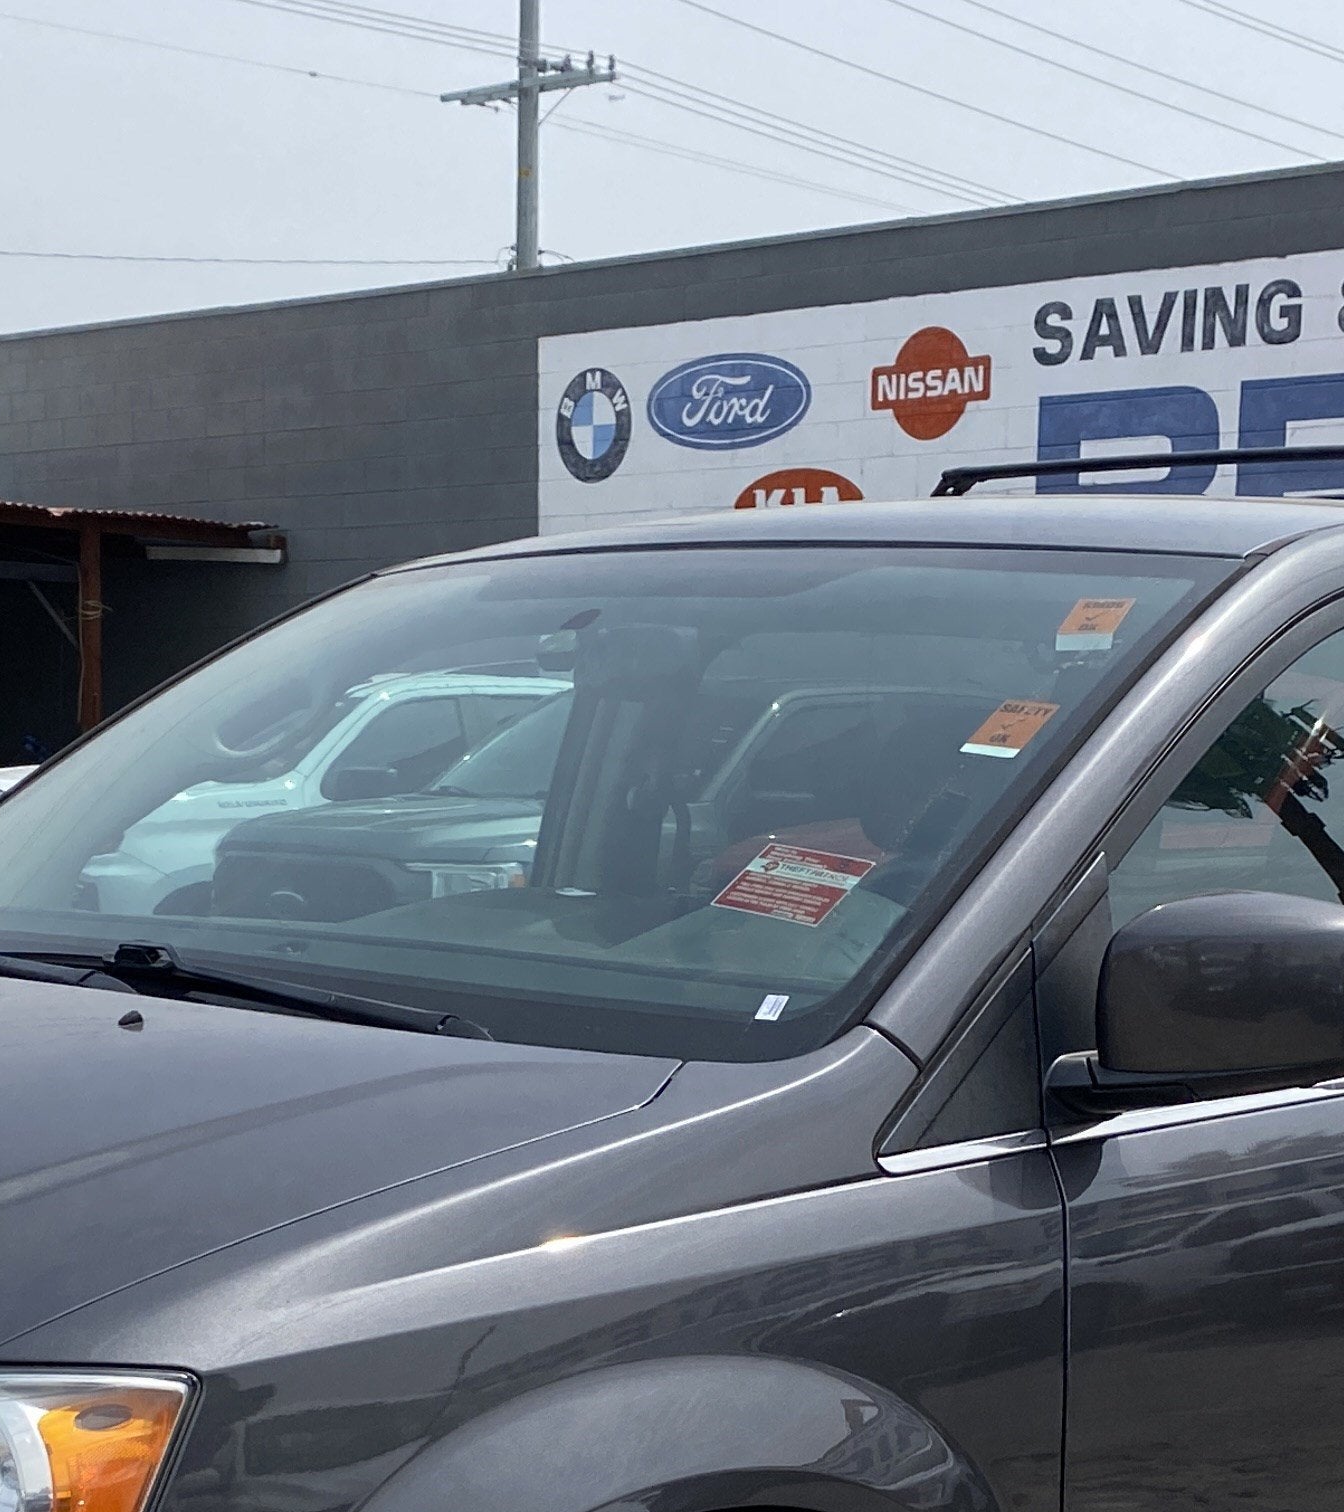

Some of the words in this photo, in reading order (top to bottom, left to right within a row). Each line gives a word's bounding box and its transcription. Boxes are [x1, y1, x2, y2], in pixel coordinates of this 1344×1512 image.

[1030, 277, 1302, 367] SAVING
[680, 373, 775, 428] Ford
[877, 365, 984, 402] NISSAN
